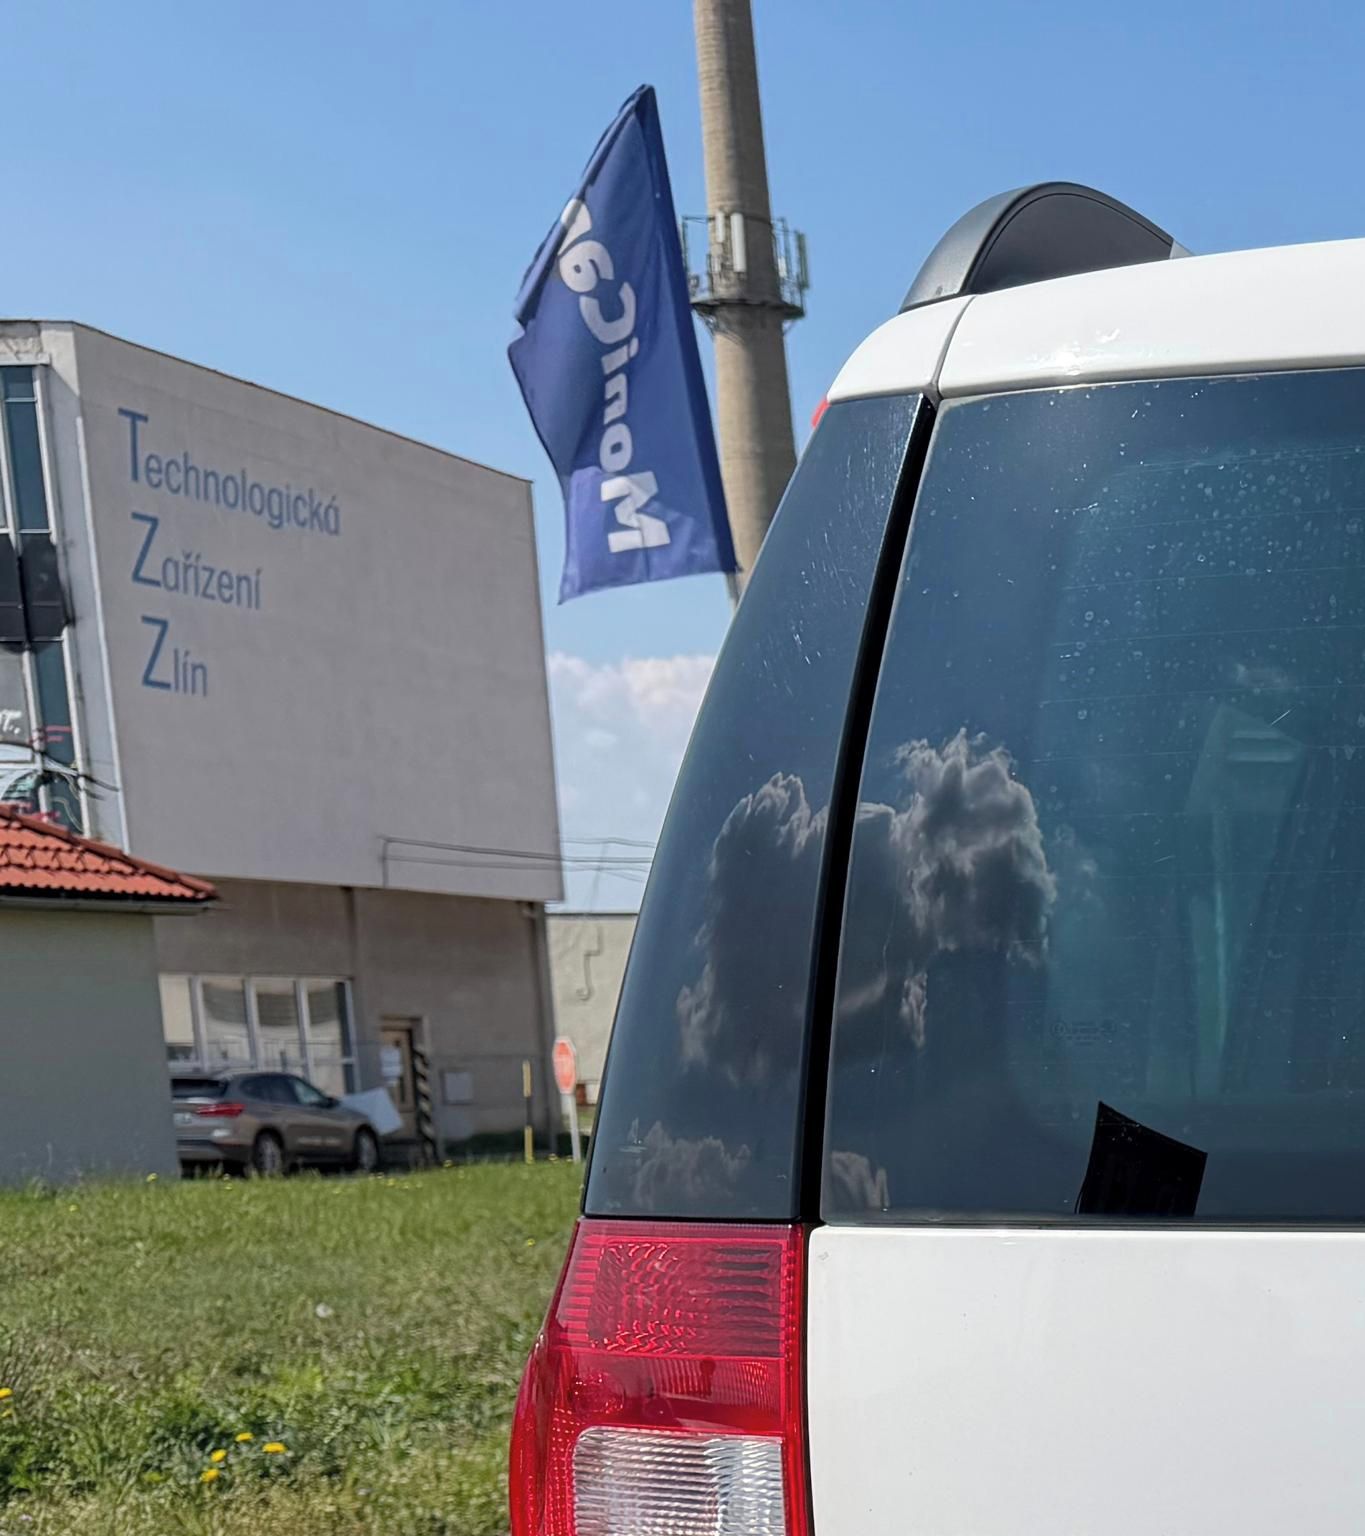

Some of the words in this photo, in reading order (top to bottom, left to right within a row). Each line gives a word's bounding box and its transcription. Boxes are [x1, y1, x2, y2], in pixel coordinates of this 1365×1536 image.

[117, 406, 341, 536] Technologická
[130, 511, 262, 611] Zařízení
[140, 614, 208, 697] Zlín
